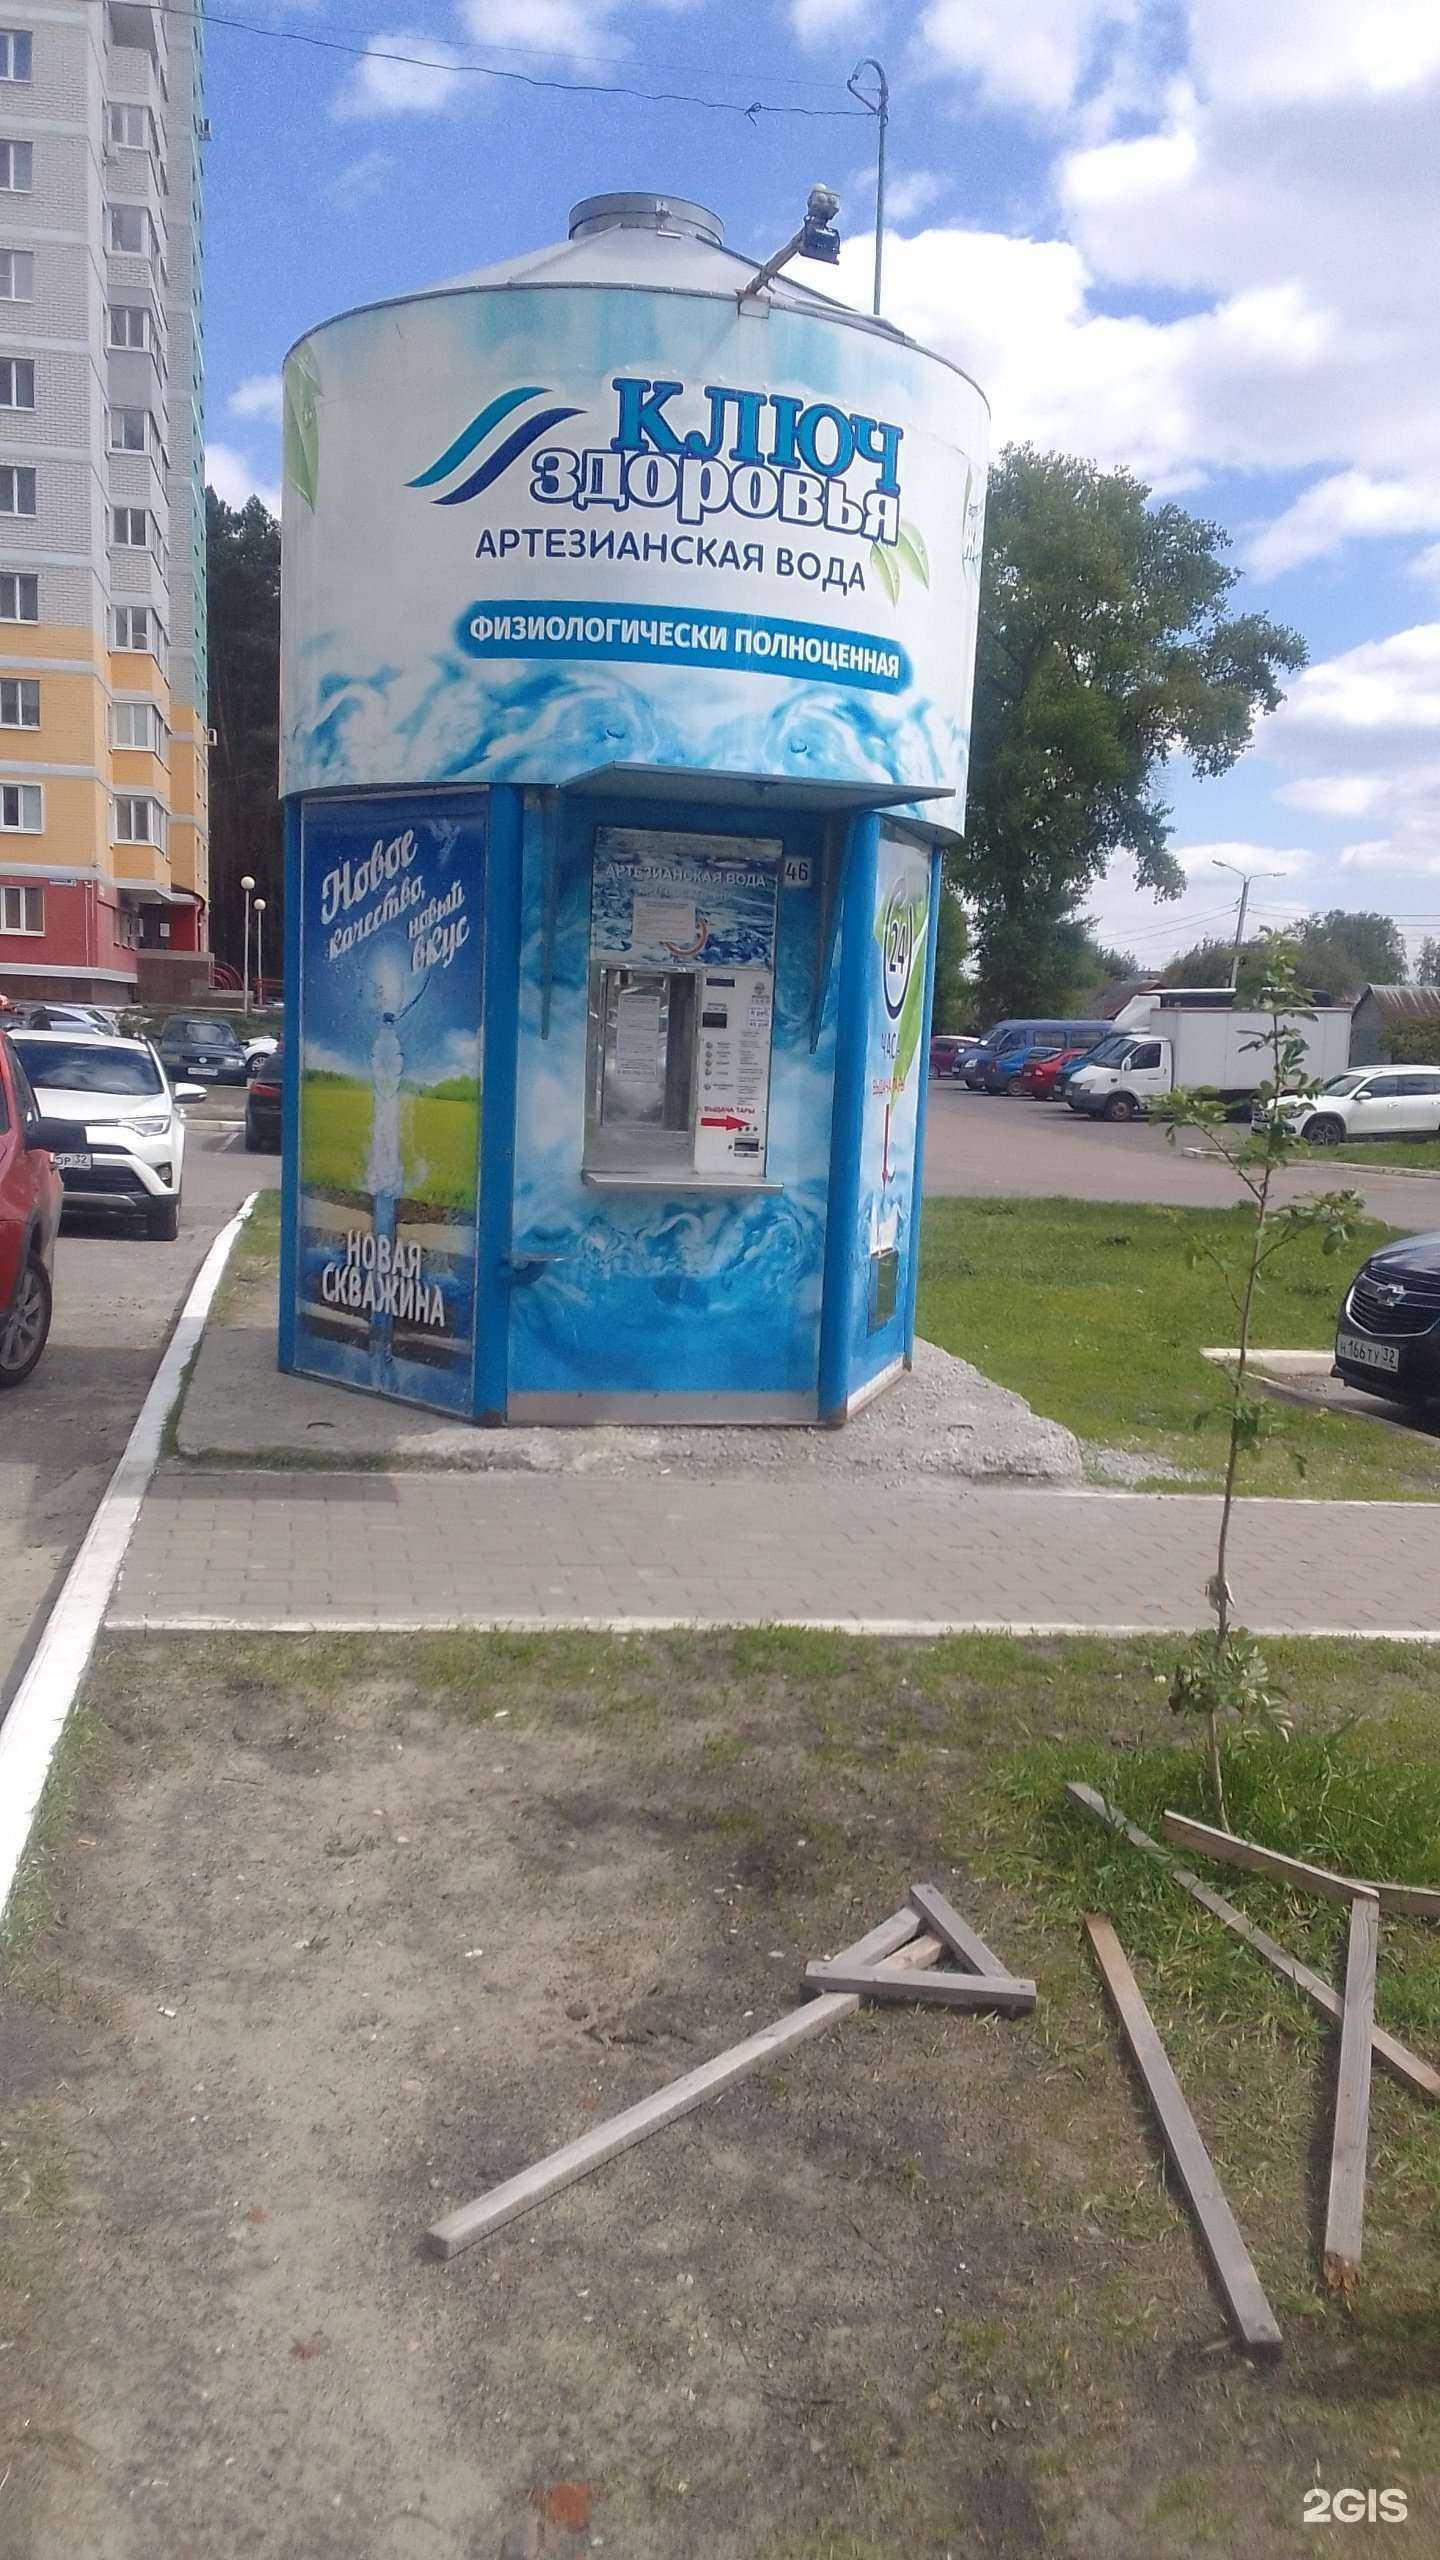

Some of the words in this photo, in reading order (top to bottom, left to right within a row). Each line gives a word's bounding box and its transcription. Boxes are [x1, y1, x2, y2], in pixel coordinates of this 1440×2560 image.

[610, 376, 904, 496] КЛЮЧ
[475, 528, 764, 573] АРТЕЗИАНСКАЯ
[776, 547, 866, 596] ВОДА
[469, 614, 728, 651] ФИЗИОЛОГИЧЕСКИ
[734, 628, 900, 680] ПОЛНОЦЕННАЯ
[320, 828, 419, 925] Новое
[606, 863, 722, 884] АРТЕЗИАНСКАЯ
[726, 872, 767, 888] ВОДА
[785, 862, 809, 881] 46
[408, 880, 466, 939] новый
[411, 915, 470, 976] вкус
[889, 921, 906, 974] 24
[347, 1228, 422, 1280] НОВАЯ
[322, 1262, 445, 1328] СКВАЖИНА
[1383, 1346, 1396, 1364] 32
